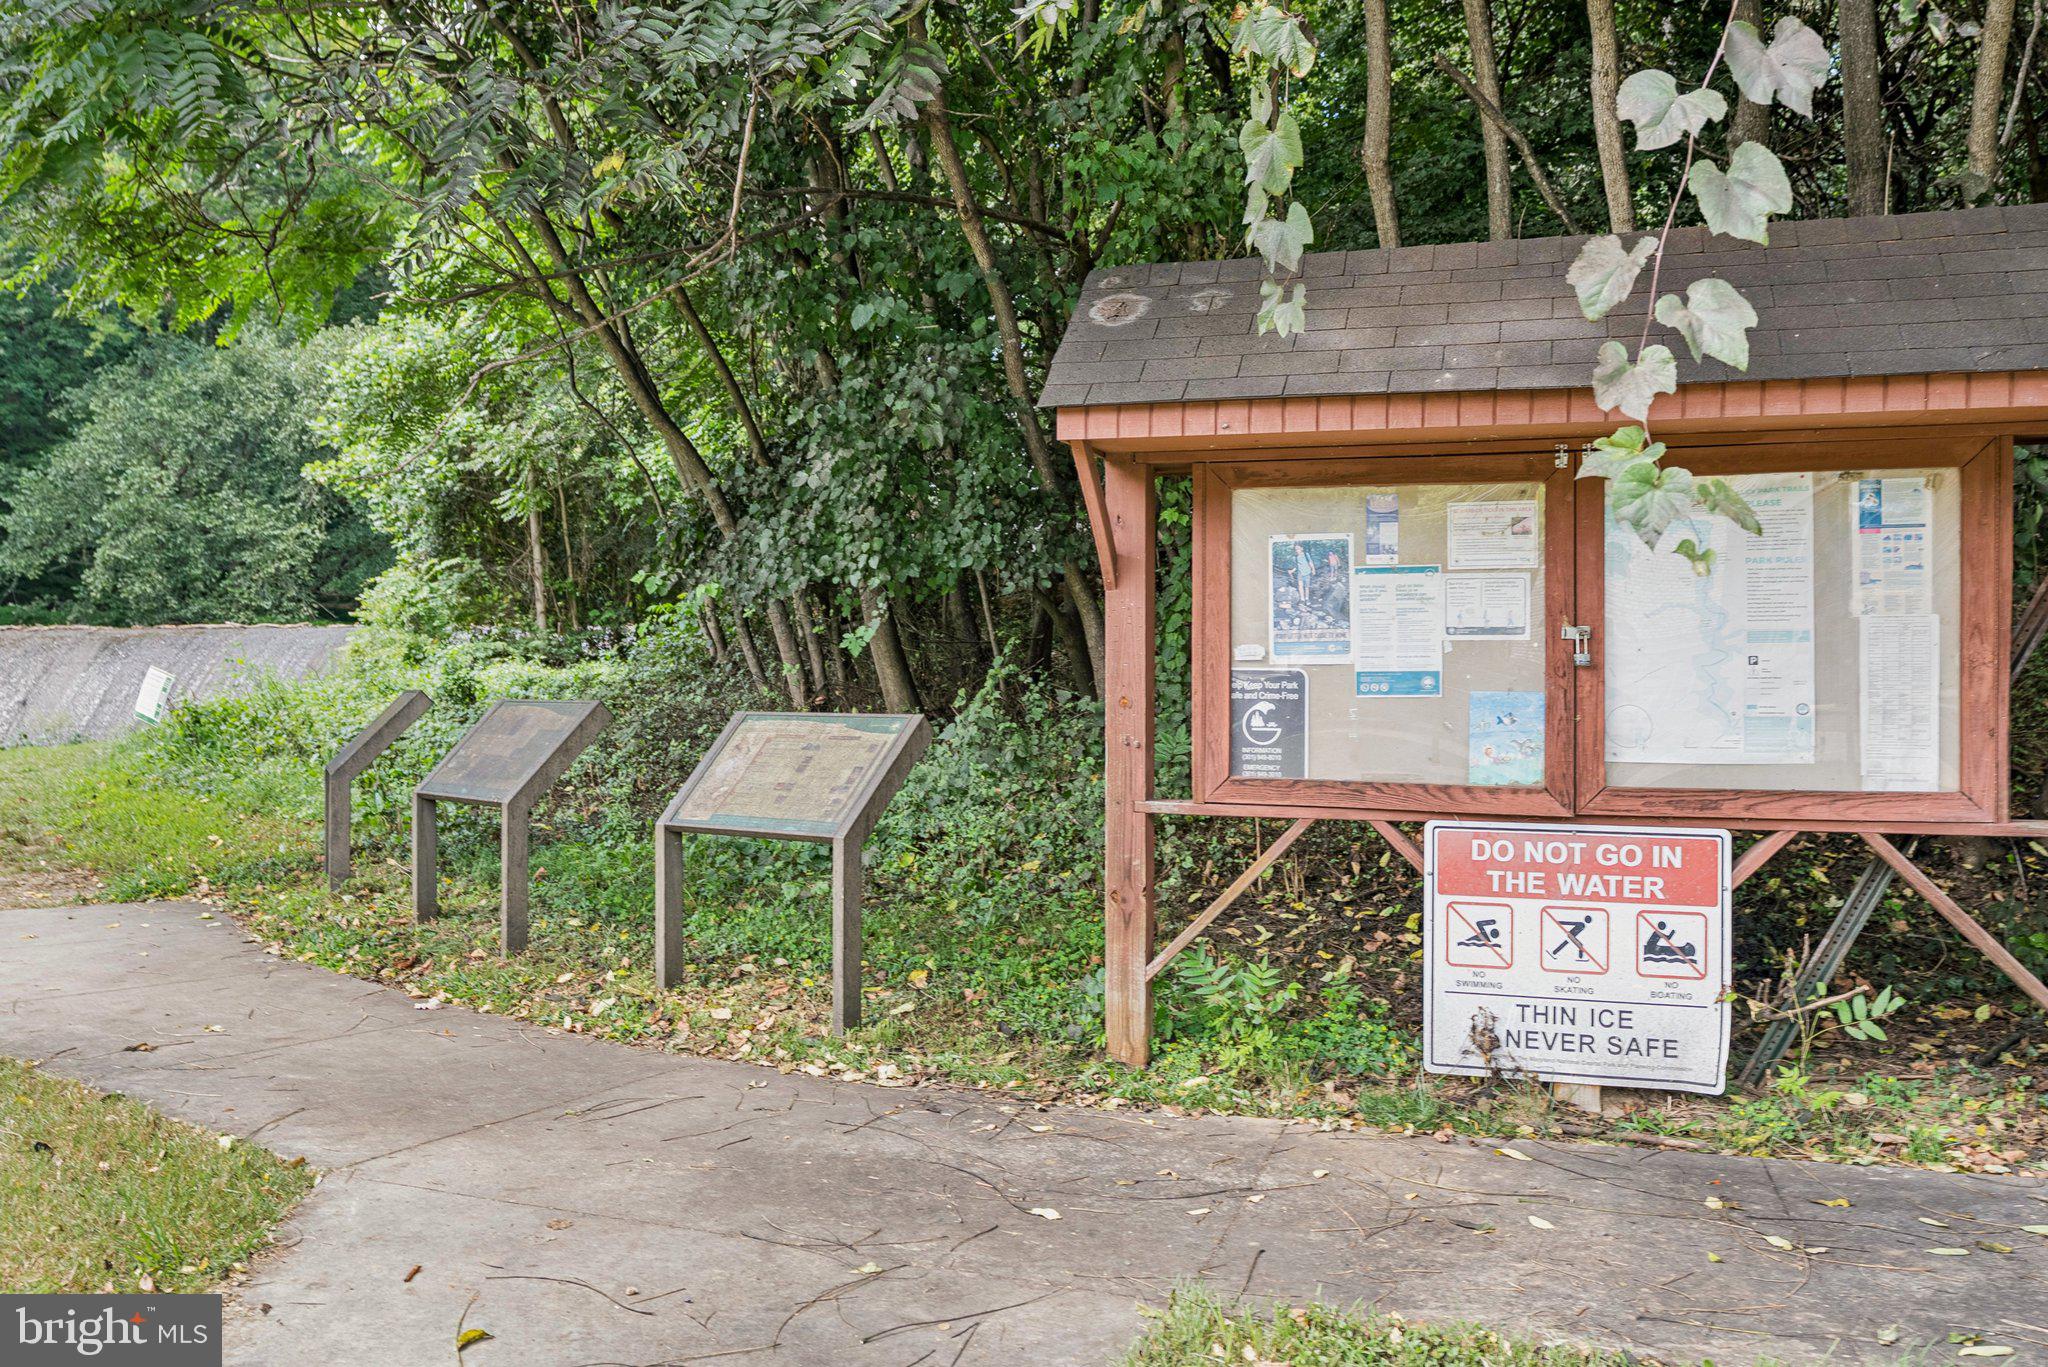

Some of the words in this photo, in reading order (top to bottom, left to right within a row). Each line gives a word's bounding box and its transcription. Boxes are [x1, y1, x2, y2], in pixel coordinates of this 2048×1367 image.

[1244, 681, 1263, 690] Keep
[1264, 681, 1280, 689] Your
[1281, 681, 1299, 689] Park
[1259, 691, 1299, 699] Crime-Free
[1471, 839, 1514, 862] DO
[1524, 841, 1587, 864] NOT
[1596, 844, 1643, 867] GO
[1652, 846, 1682, 868] IN
[1486, 870, 1546, 894] THE
[1557, 873, 1666, 899] WATER
[1456, 979, 1503, 990] SWIMMING
[1554, 985, 1594, 995] SKATING
[1650, 991, 1693, 1001] BOATING
[1516, 1004, 1576, 1026] THIN
[1591, 1008, 1634, 1030] ICE
[1505, 1029, 1596, 1054] NEVER
[1607, 1036, 1679, 1059] SAFE
